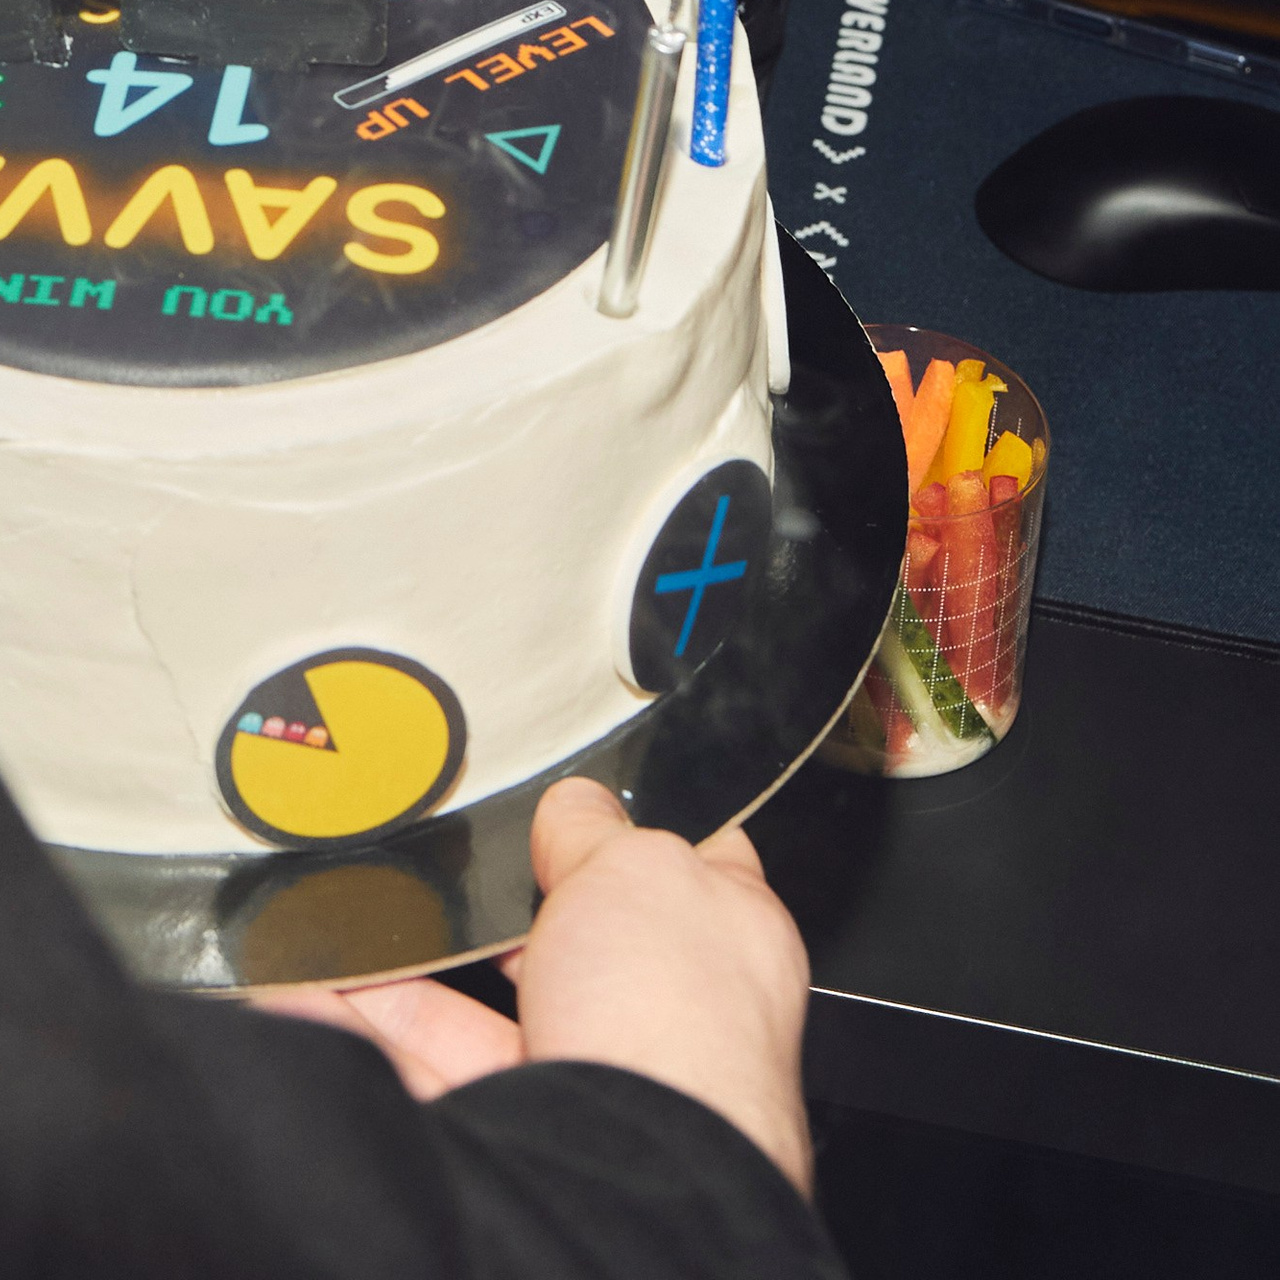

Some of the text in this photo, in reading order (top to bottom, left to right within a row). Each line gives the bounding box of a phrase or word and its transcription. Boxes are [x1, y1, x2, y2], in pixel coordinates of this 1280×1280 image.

[85, 50, 270, 147] 14
[356, 16, 613, 141] LEVEL UP
[161, 284, 294, 326] YOU
